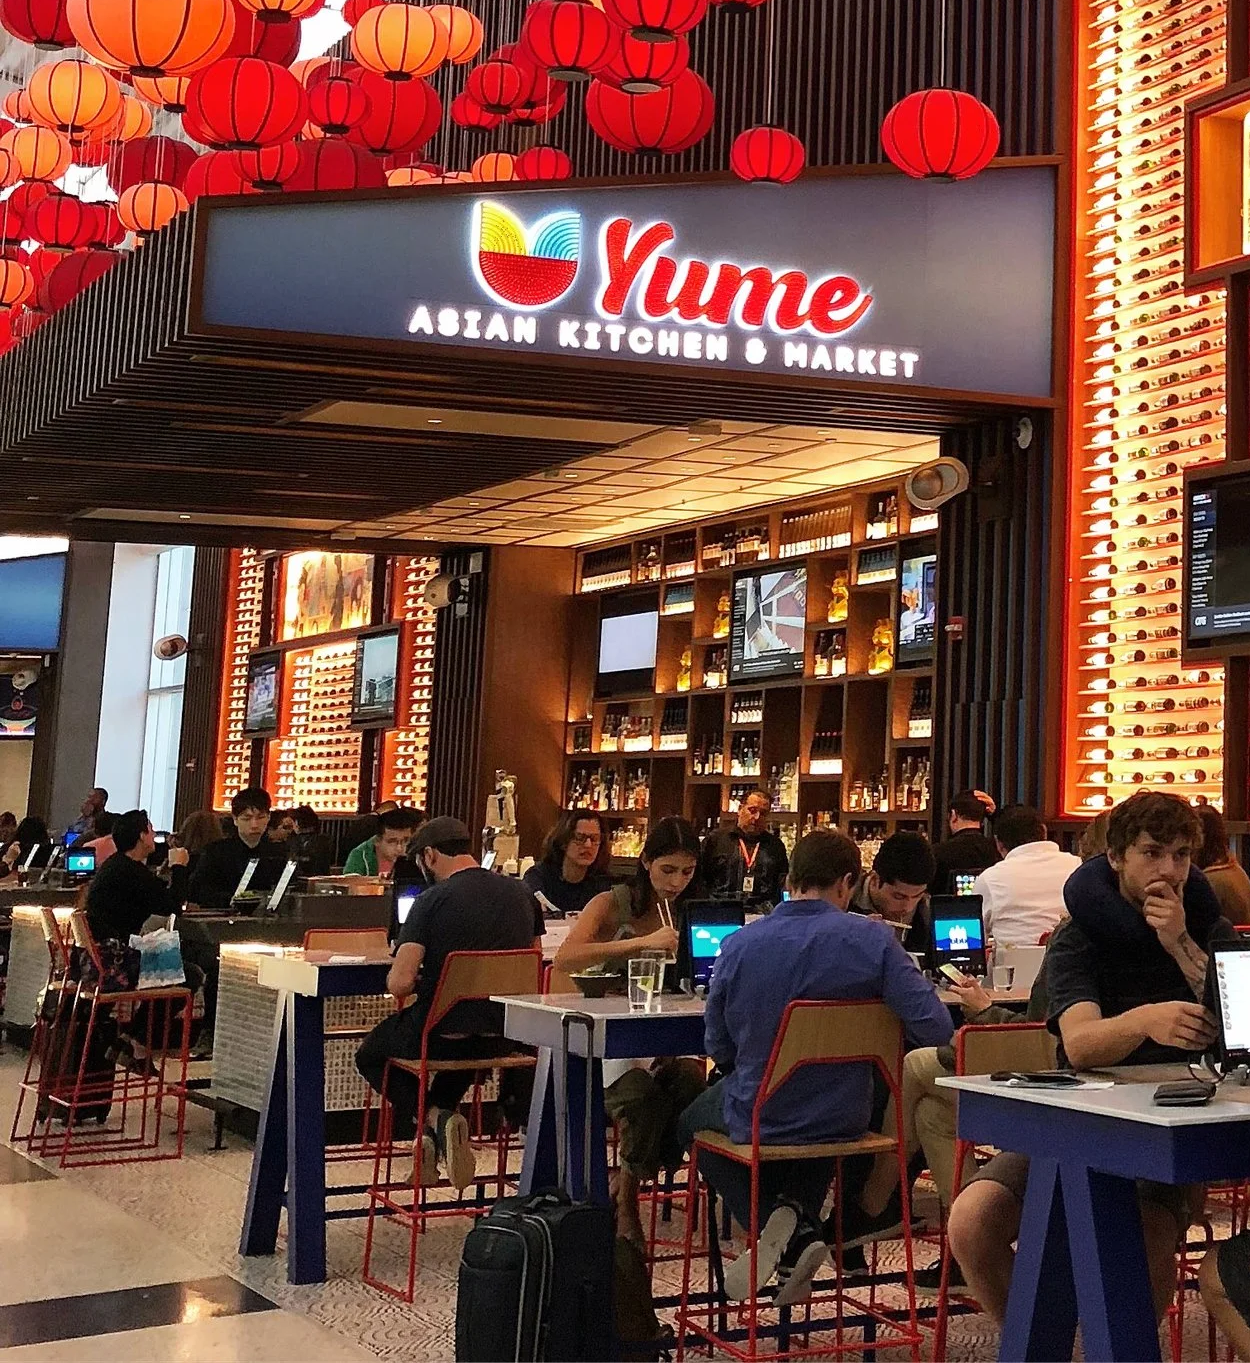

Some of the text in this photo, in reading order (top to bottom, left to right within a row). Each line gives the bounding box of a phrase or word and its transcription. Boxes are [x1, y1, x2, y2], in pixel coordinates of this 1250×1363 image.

[601, 217, 873, 334] Yume
[408, 306, 920, 378] ASIAN KITCHEN & MARKET
